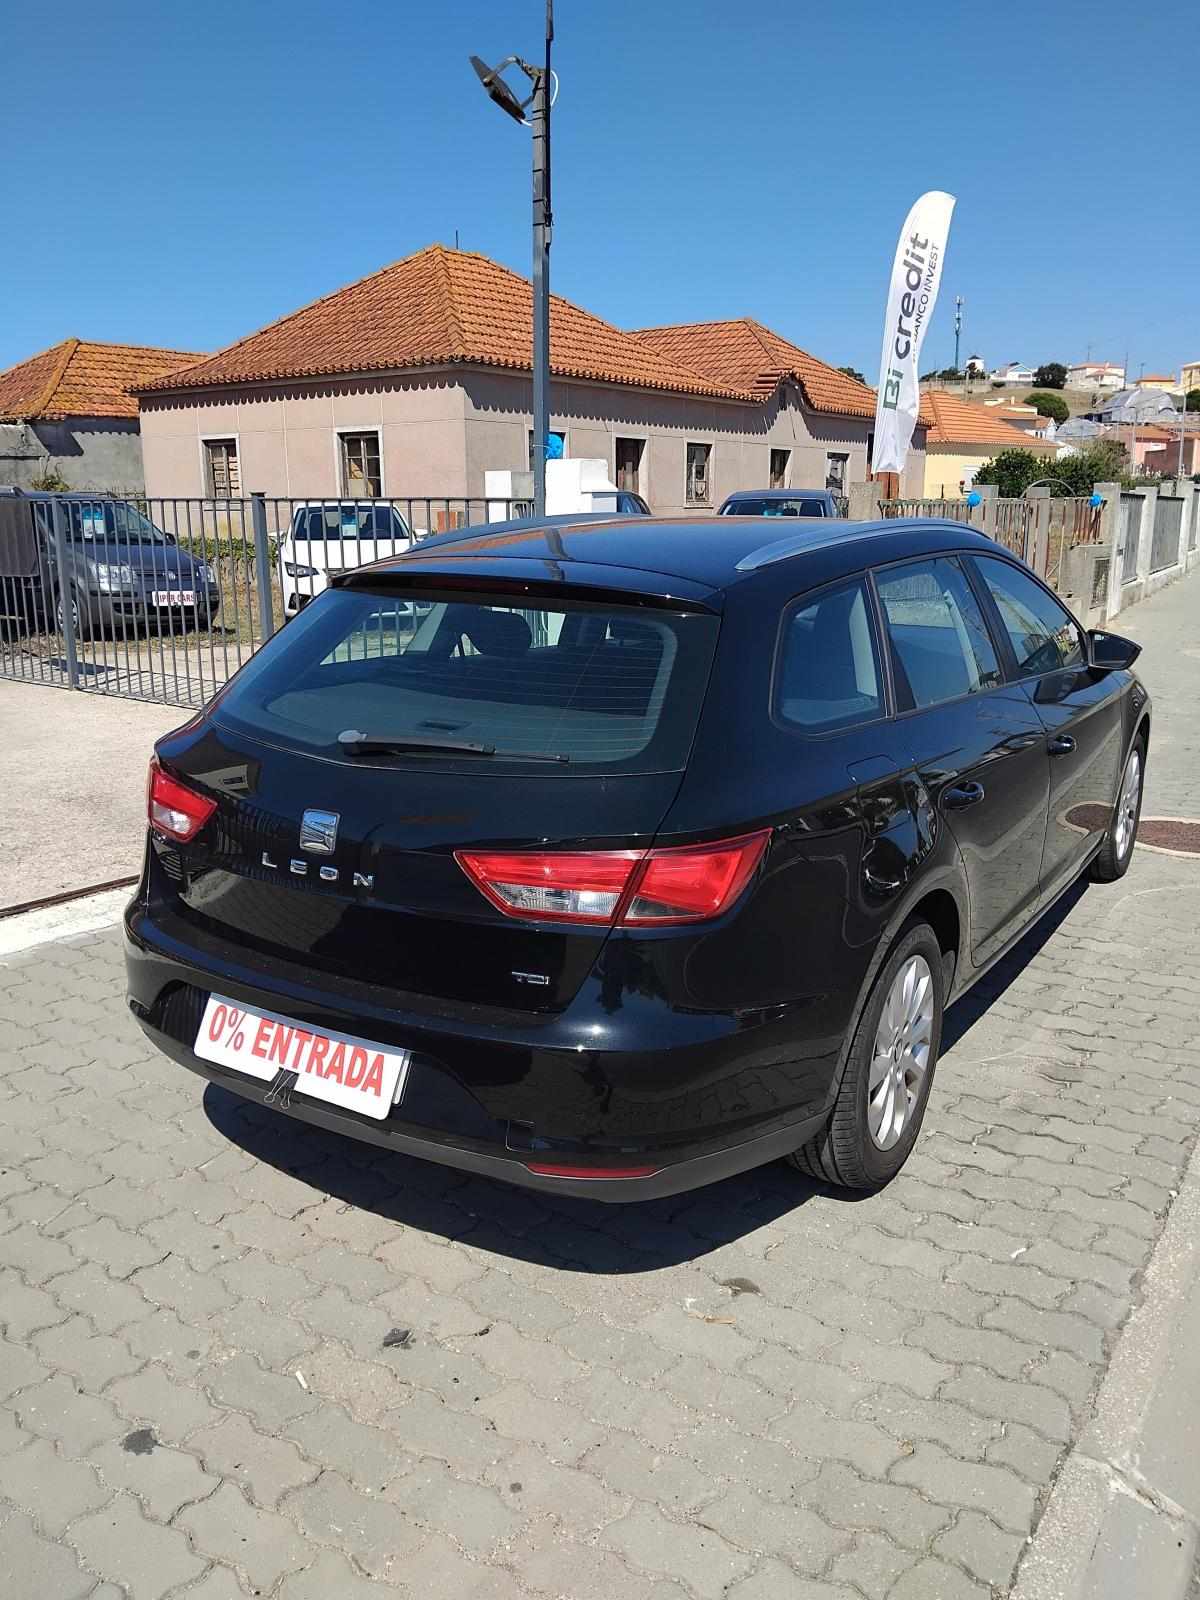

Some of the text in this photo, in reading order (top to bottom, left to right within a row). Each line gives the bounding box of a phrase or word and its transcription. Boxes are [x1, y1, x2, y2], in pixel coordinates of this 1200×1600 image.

[923, 244, 939, 292] INVEST
[883, 232, 928, 410] Bi credit
[261, 851, 375, 888] LEON
[208, 1004, 386, 1097] 0% ENTRADA
